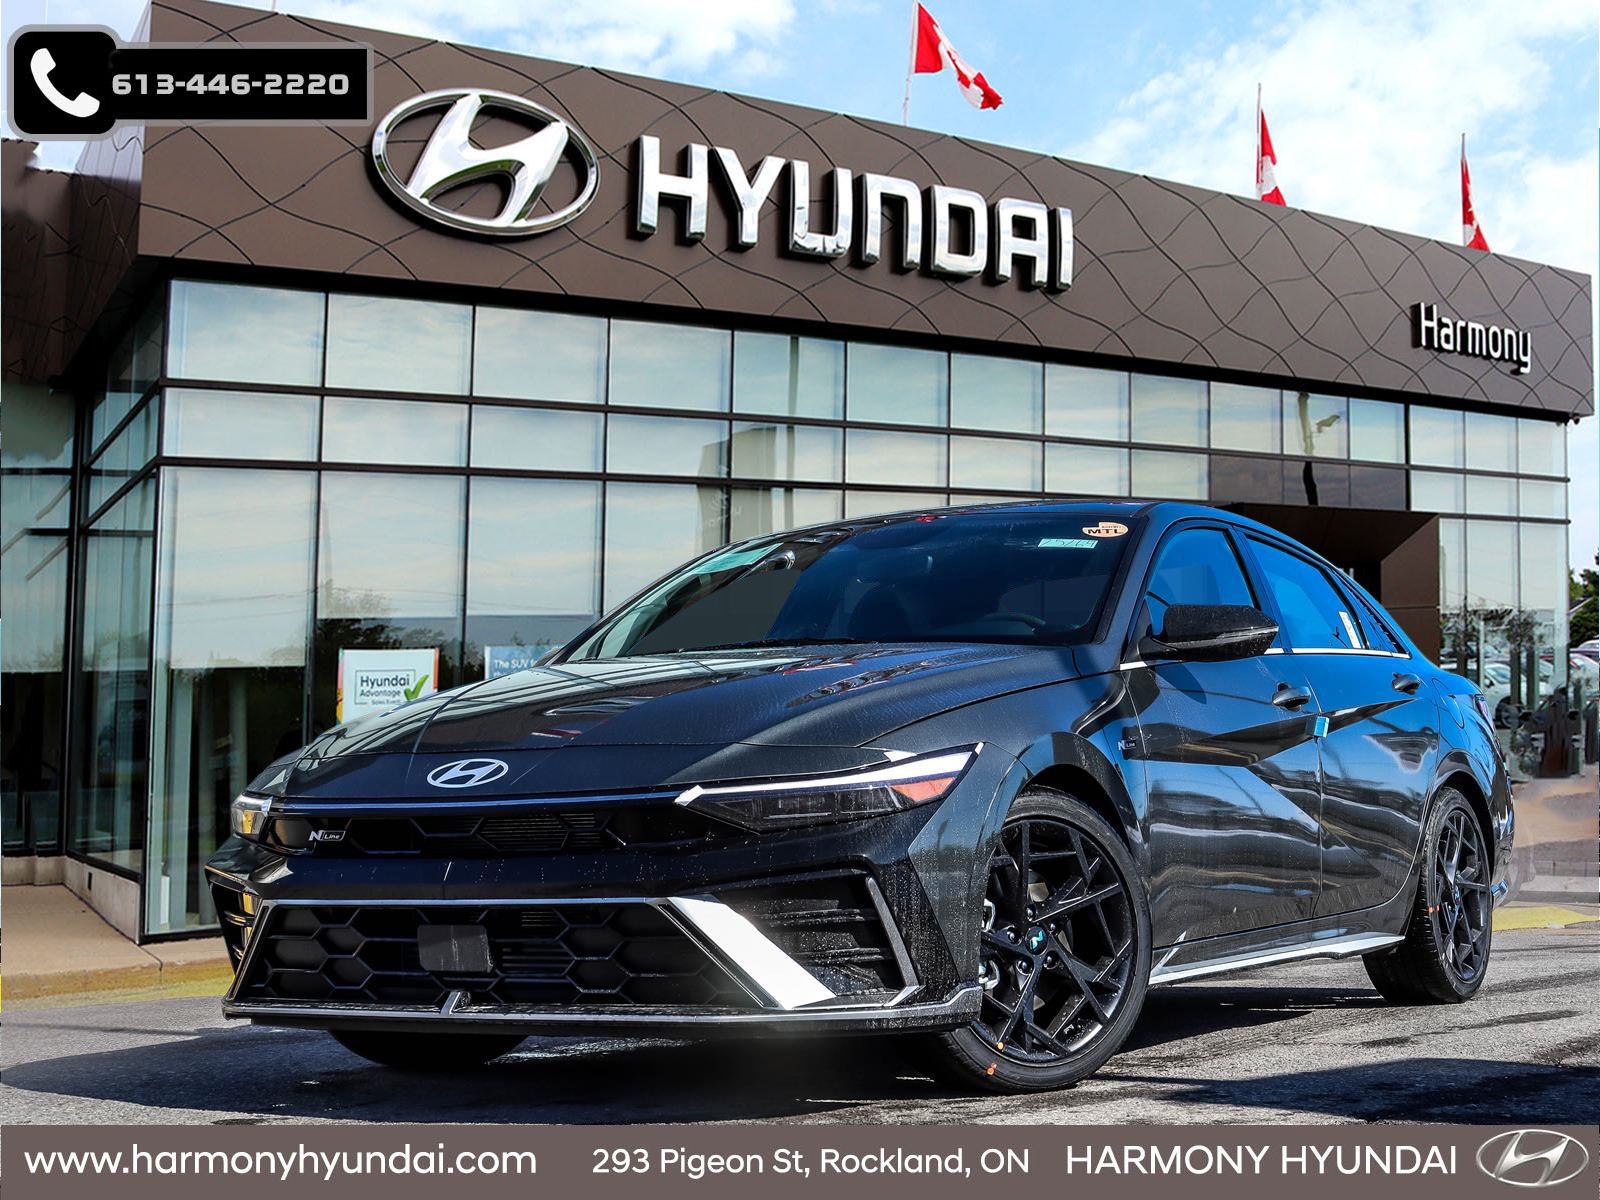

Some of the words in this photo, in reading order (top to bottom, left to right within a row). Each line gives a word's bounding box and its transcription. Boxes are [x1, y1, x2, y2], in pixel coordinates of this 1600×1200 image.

[636, 134, 1075, 292] HYUNDAI
[1419, 301, 1533, 375] Harmony
[511, 658, 529, 669] SUV
[360, 674, 410, 689] Hyundai
[360, 690, 401, 698] Advantage
